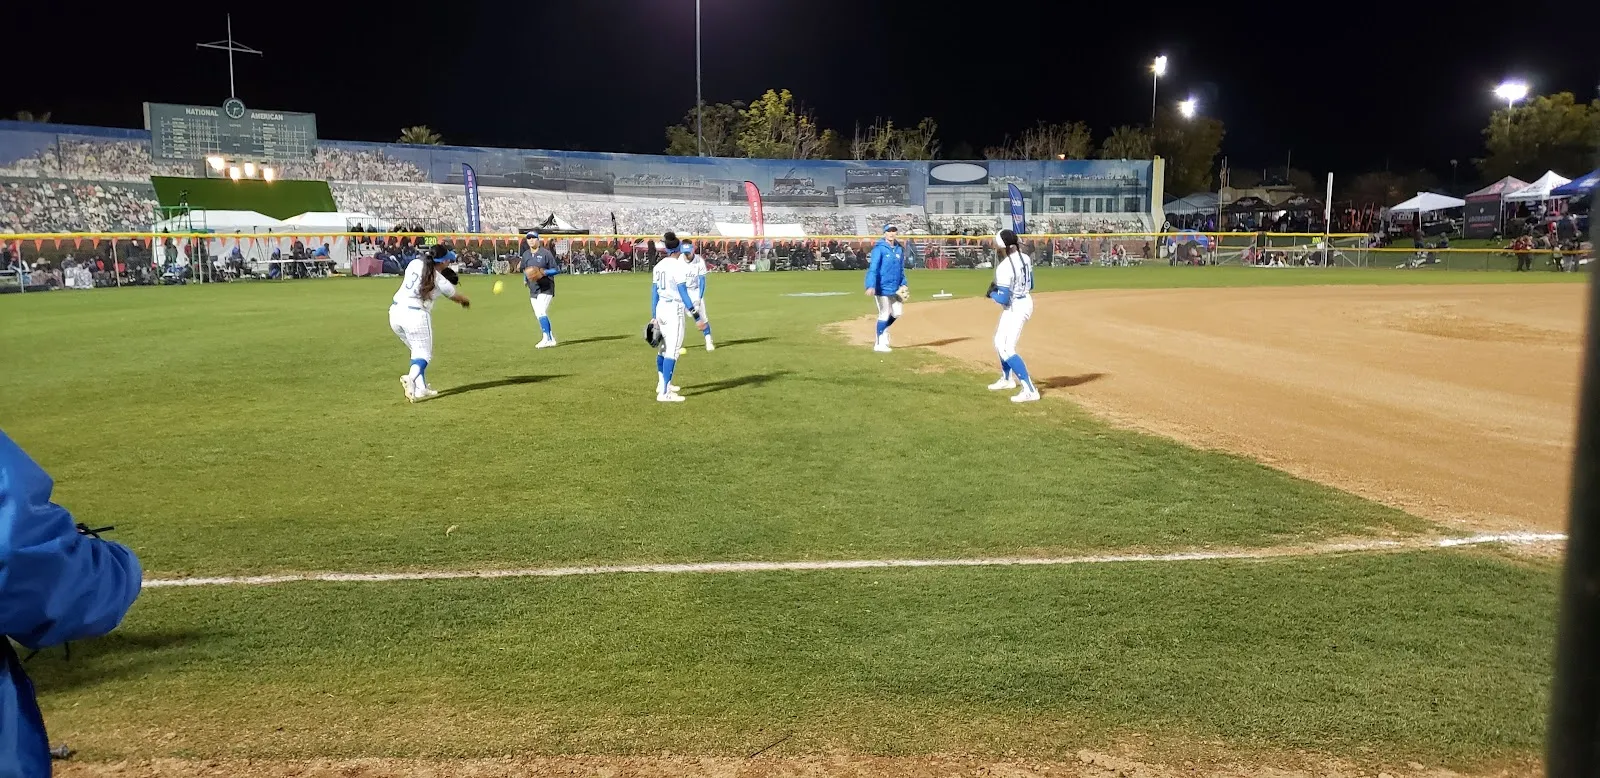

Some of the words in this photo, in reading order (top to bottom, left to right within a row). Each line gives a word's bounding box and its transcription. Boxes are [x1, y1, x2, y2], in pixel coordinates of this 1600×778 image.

[185, 107, 219, 117] NATIONAL
[250, 112, 284, 121] AMERICAN
[424, 236, 437, 246] 220
